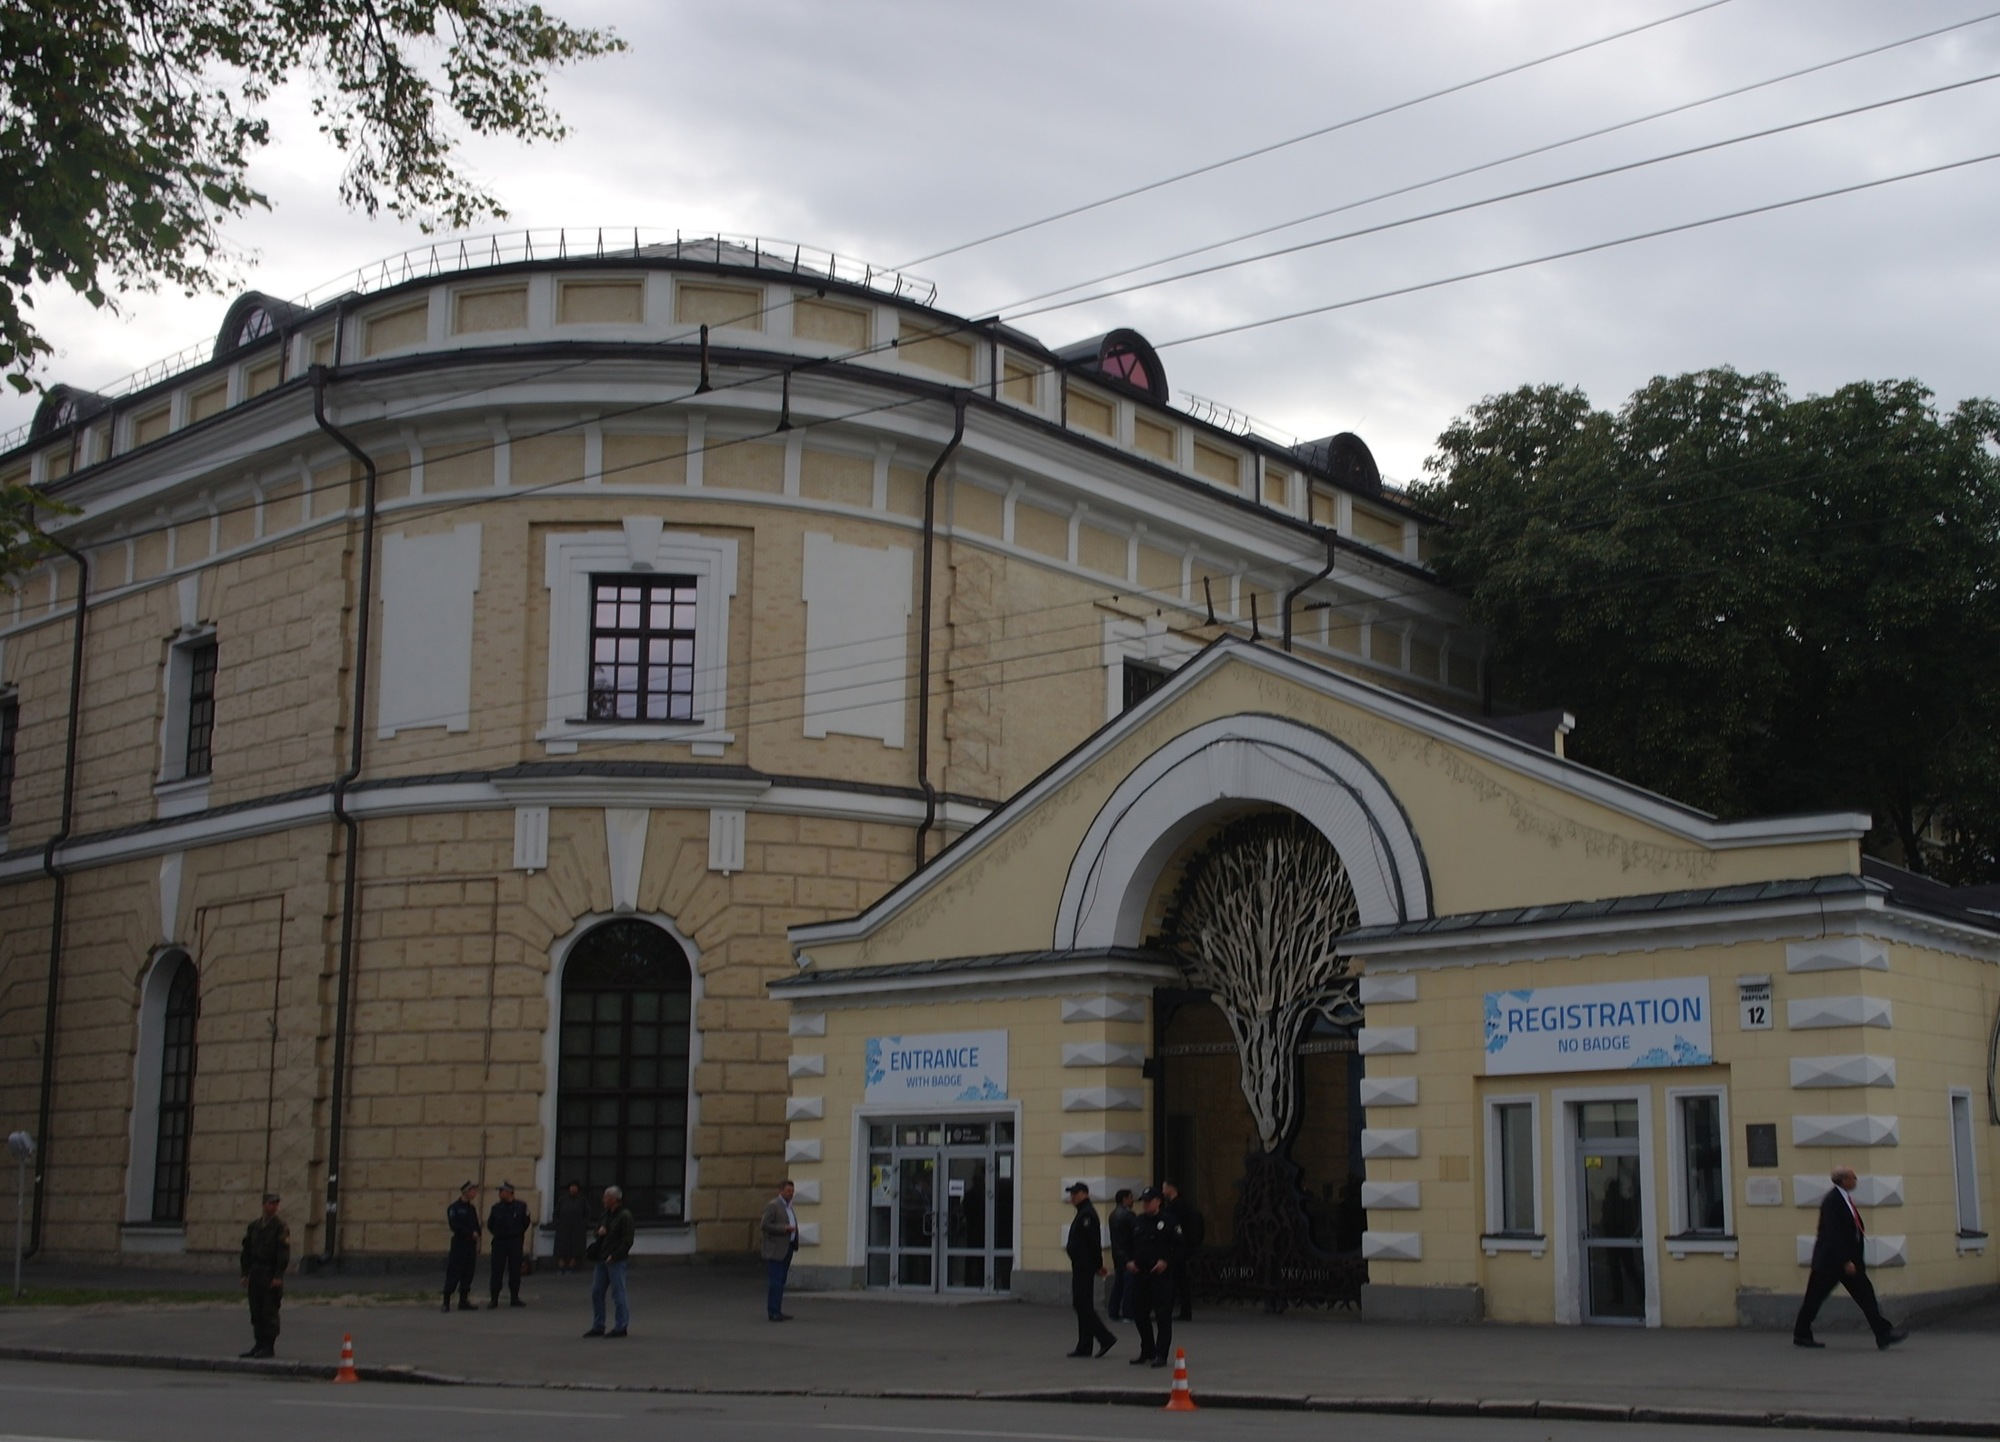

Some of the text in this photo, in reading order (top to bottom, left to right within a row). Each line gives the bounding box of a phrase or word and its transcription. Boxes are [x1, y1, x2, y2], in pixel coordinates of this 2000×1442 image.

[1507, 996, 1702, 1034] REGISTRATION
[1747, 1006, 1765, 1025] 12
[1558, 1035, 1631, 1053] NO BADGE
[891, 1047, 979, 1071] ENTRANCE
[906, 1074, 962, 1088] WITH BADGE
